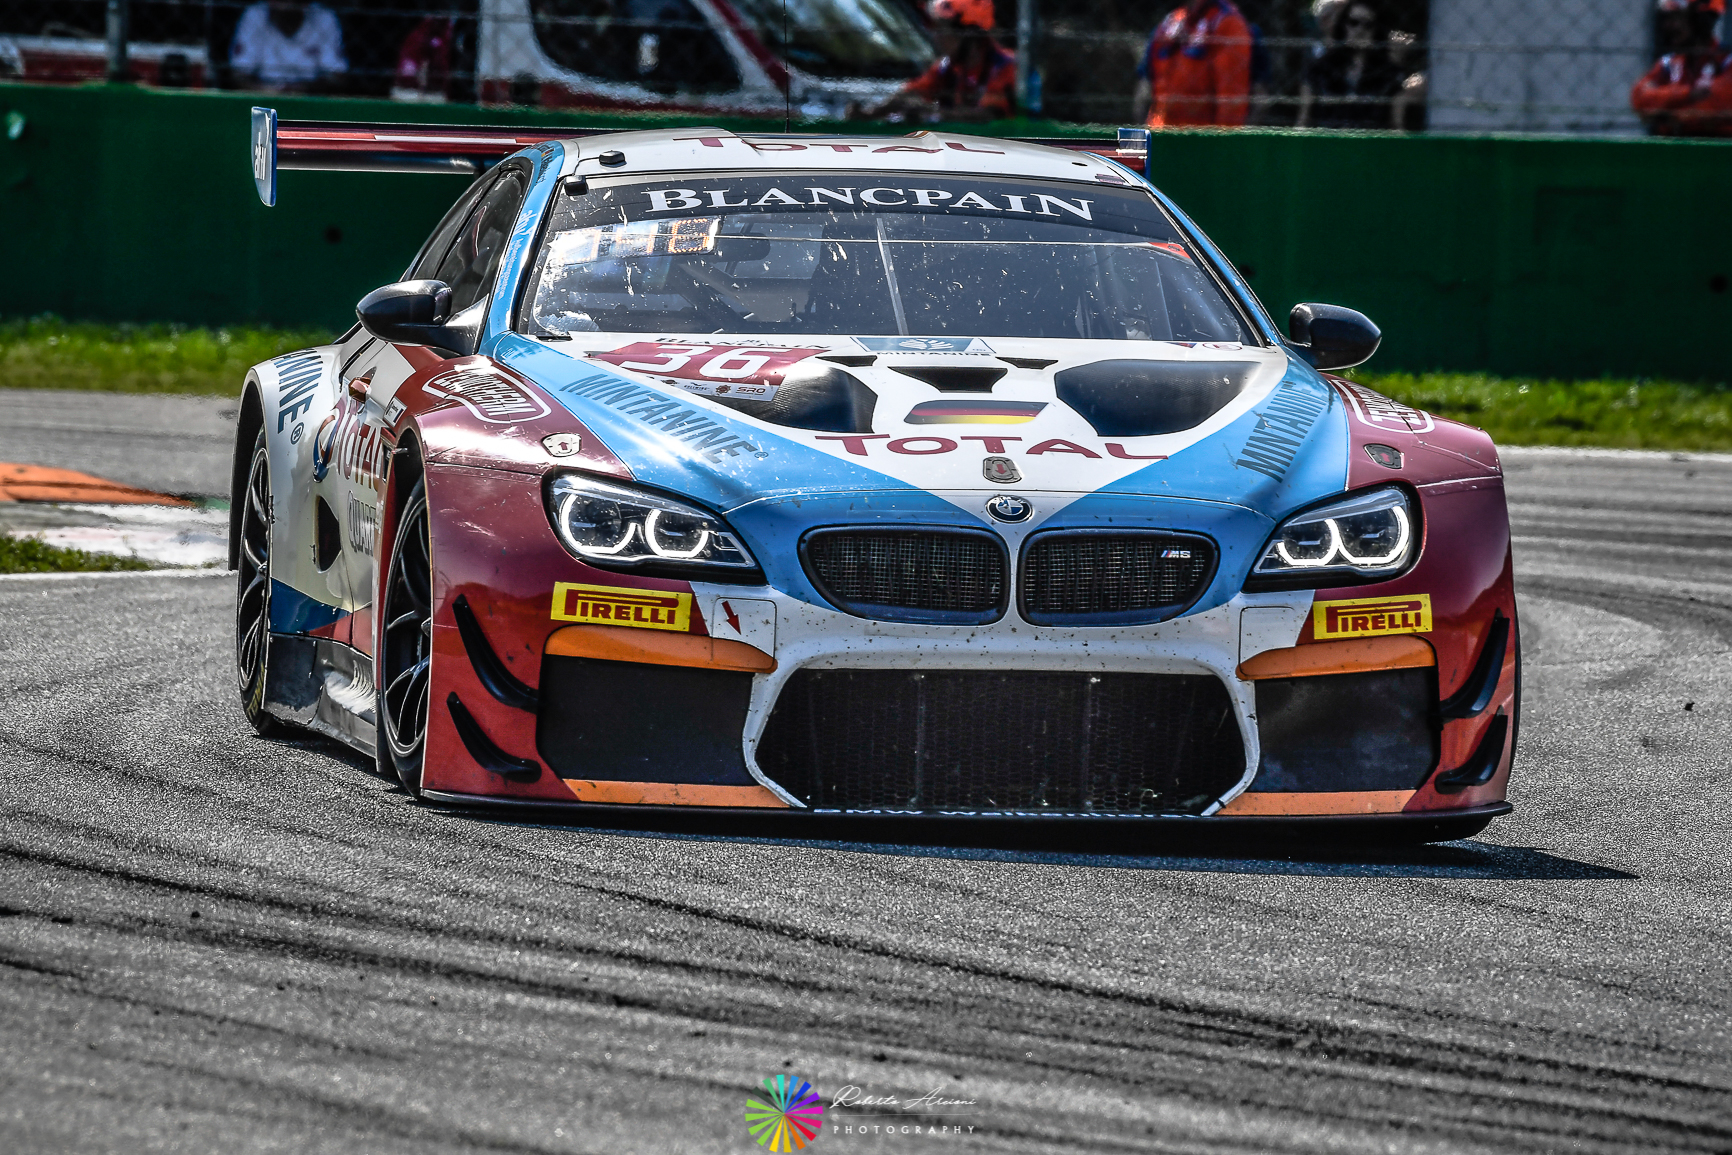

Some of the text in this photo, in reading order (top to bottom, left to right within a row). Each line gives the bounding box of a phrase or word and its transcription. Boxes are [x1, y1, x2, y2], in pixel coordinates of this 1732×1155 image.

[673, 136, 1005, 154] TOTAL
[645, 187, 1095, 221] BLANCPAIN
[619, 344, 793, 379] 36
[814, 434, 1169, 460] TOTAL
[563, 588, 680, 624] PIRELLI
[1325, 600, 1423, 634] PIRELLI
